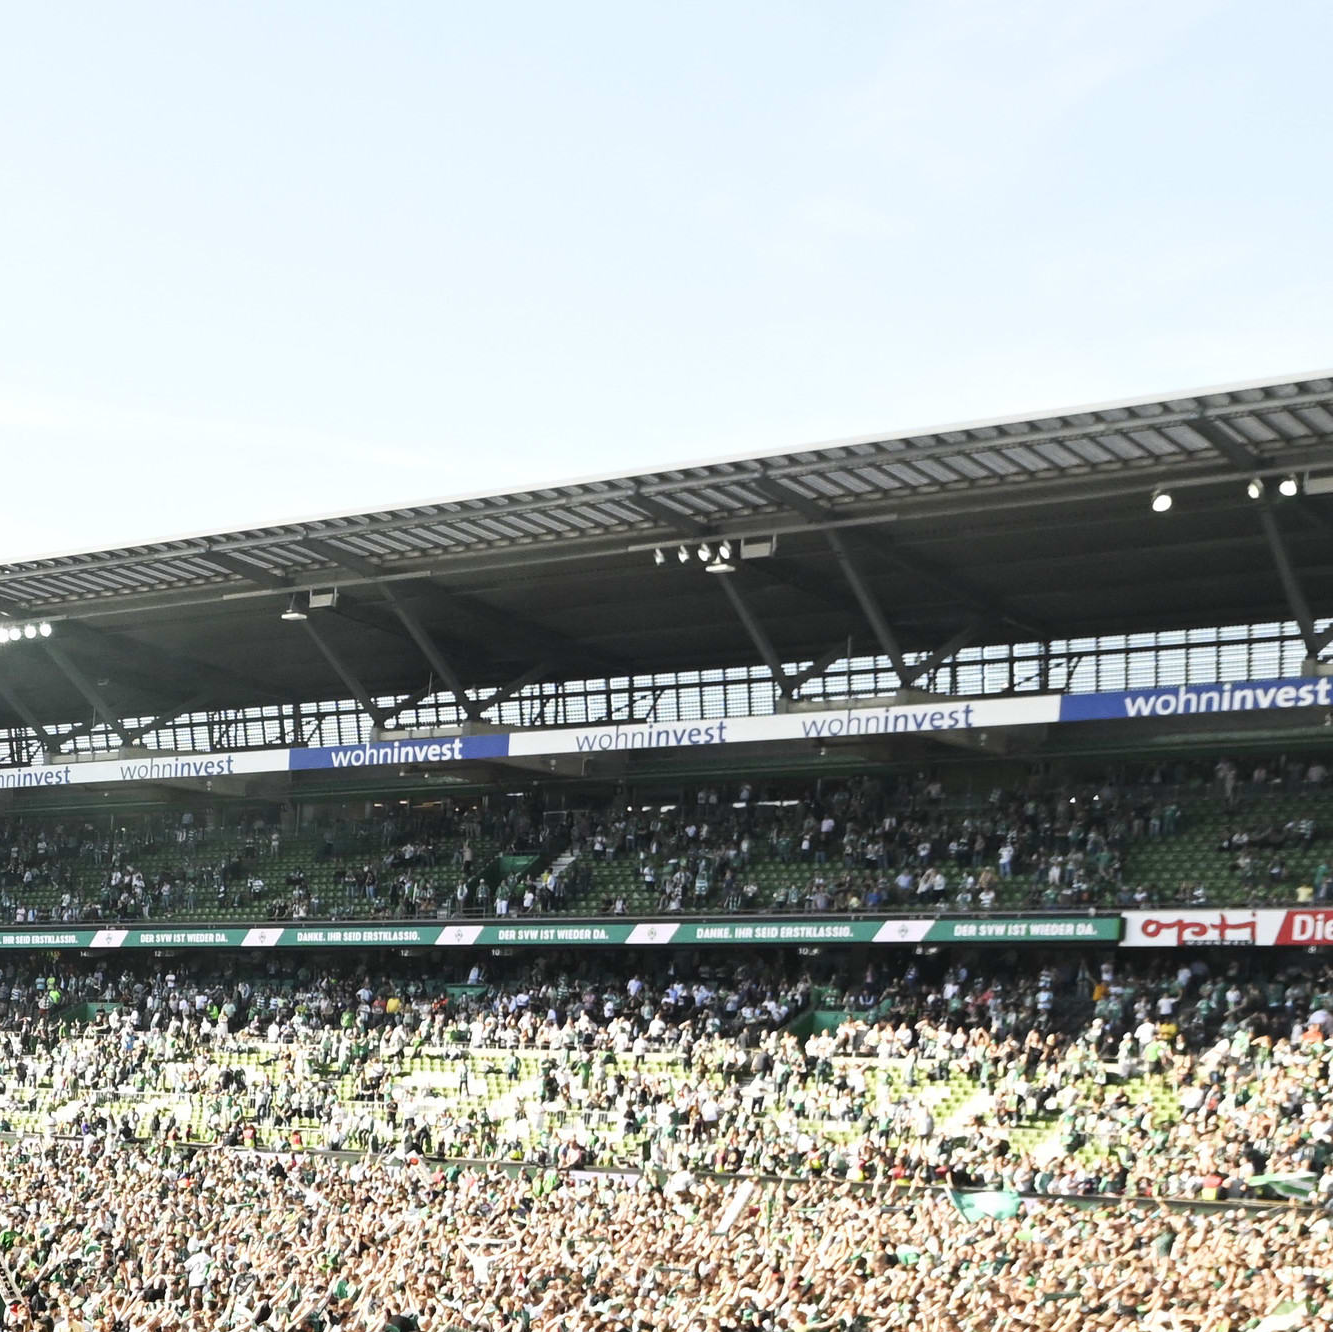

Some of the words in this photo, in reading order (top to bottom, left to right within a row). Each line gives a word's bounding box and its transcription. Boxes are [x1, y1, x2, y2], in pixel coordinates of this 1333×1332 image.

[1124, 678, 1332, 717] wohninvest
[801, 703, 974, 738] wohninvest
[575, 720, 727, 751] wohninvest
[331, 738, 463, 768] wohninvest
[120, 755, 233, 781] wohninvest
[140, 933, 154, 943] DER
[156, 933, 172, 943] SVW
[173, 933, 184, 943] IST
[185, 933, 213, 943] WIEDER
[215, 933, 228, 943] DA.
[297, 931, 325, 942] DANKE.
[327, 931, 341, 942] IHR
[342, 931, 361, 941] SEID
[362, 931, 420, 941] ERSTKLASSIG.
[498, 930, 515, 940] DER
[517, 929, 538, 940] SVW
[540, 929, 554, 940] IST
[556, 929, 591, 940] WIEDER
[593, 929, 609, 939] DA.
[696, 926, 732, 939] DANKE.
[735, 926, 752, 938] IHR
[754, 926, 778, 938] SEID
[779, 925, 854, 938] ERSTKLASSIG.
[954, 924, 977, 937] DER
[979, 924, 1005, 936] SVW
[1006, 924, 1026, 936] IST
[1028, 923, 1073, 936] WIEDER
[1076, 923, 1098, 935] DA.
[1141, 912, 1256, 946] opti
[3, 935, 14, 945] IHR
[15, 935, 30, 945] SEID
[31, 935, 78, 944] ERSTKLASSIG.
